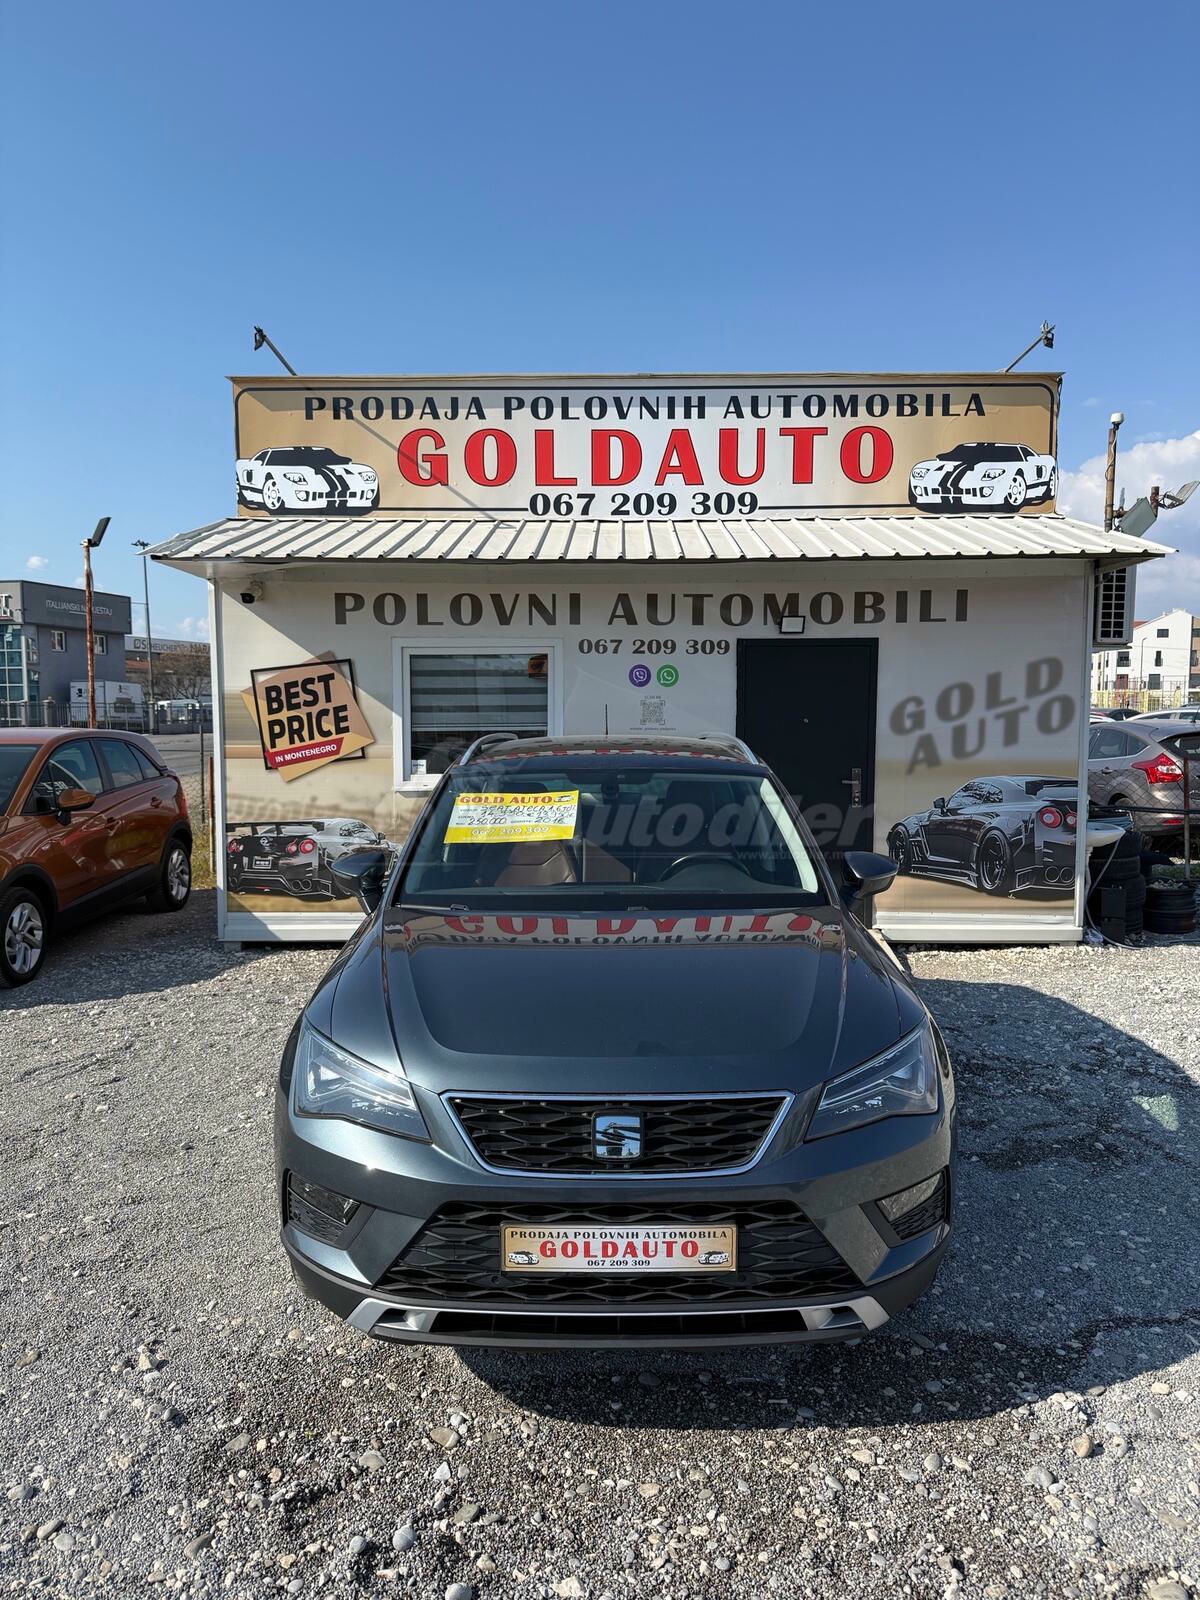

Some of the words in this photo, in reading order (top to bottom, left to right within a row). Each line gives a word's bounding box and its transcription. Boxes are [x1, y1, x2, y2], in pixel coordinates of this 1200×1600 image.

[304, 396, 487, 420] PRODAJA
[503, 395, 706, 420] POLOVNIH
[723, 393, 986, 419] AUTOMOBILA
[397, 425, 894, 488] GOLDAUTO
[529, 492, 596, 516] 067
[610, 492, 677, 516] 209
[691, 491, 759, 515] 309
[333, 592, 581, 626] POLOVNI
[607, 588, 969, 626] AUTOMOBILI
[578, 638, 624, 655] 067
[631, 639, 677, 655] 209
[685, 639, 730, 655] 309
[265, 672, 335, 716] BEST
[889, 656, 1064, 736] GOLD
[267, 704, 350, 749] PRICE
[905, 694, 1076, 775] AUTO
[275, 755, 284, 763] IN
[284, 743, 337, 761] MONTENEGRO
[459, 795, 505, 804] GOLD
[509, 795, 553, 804] AUTO
[511, 1230, 569, 1240] PRODAJA
[573, 1231, 639, 1240] POLOVNIH
[643, 1230, 728, 1239] AUTOMOBILA
[539, 1240, 699, 1258] GOLDAUTO
[587, 1259, 606, 1267] 067
[609, 1259, 629, 1267] 209
[631, 1259, 651, 1267] 309
